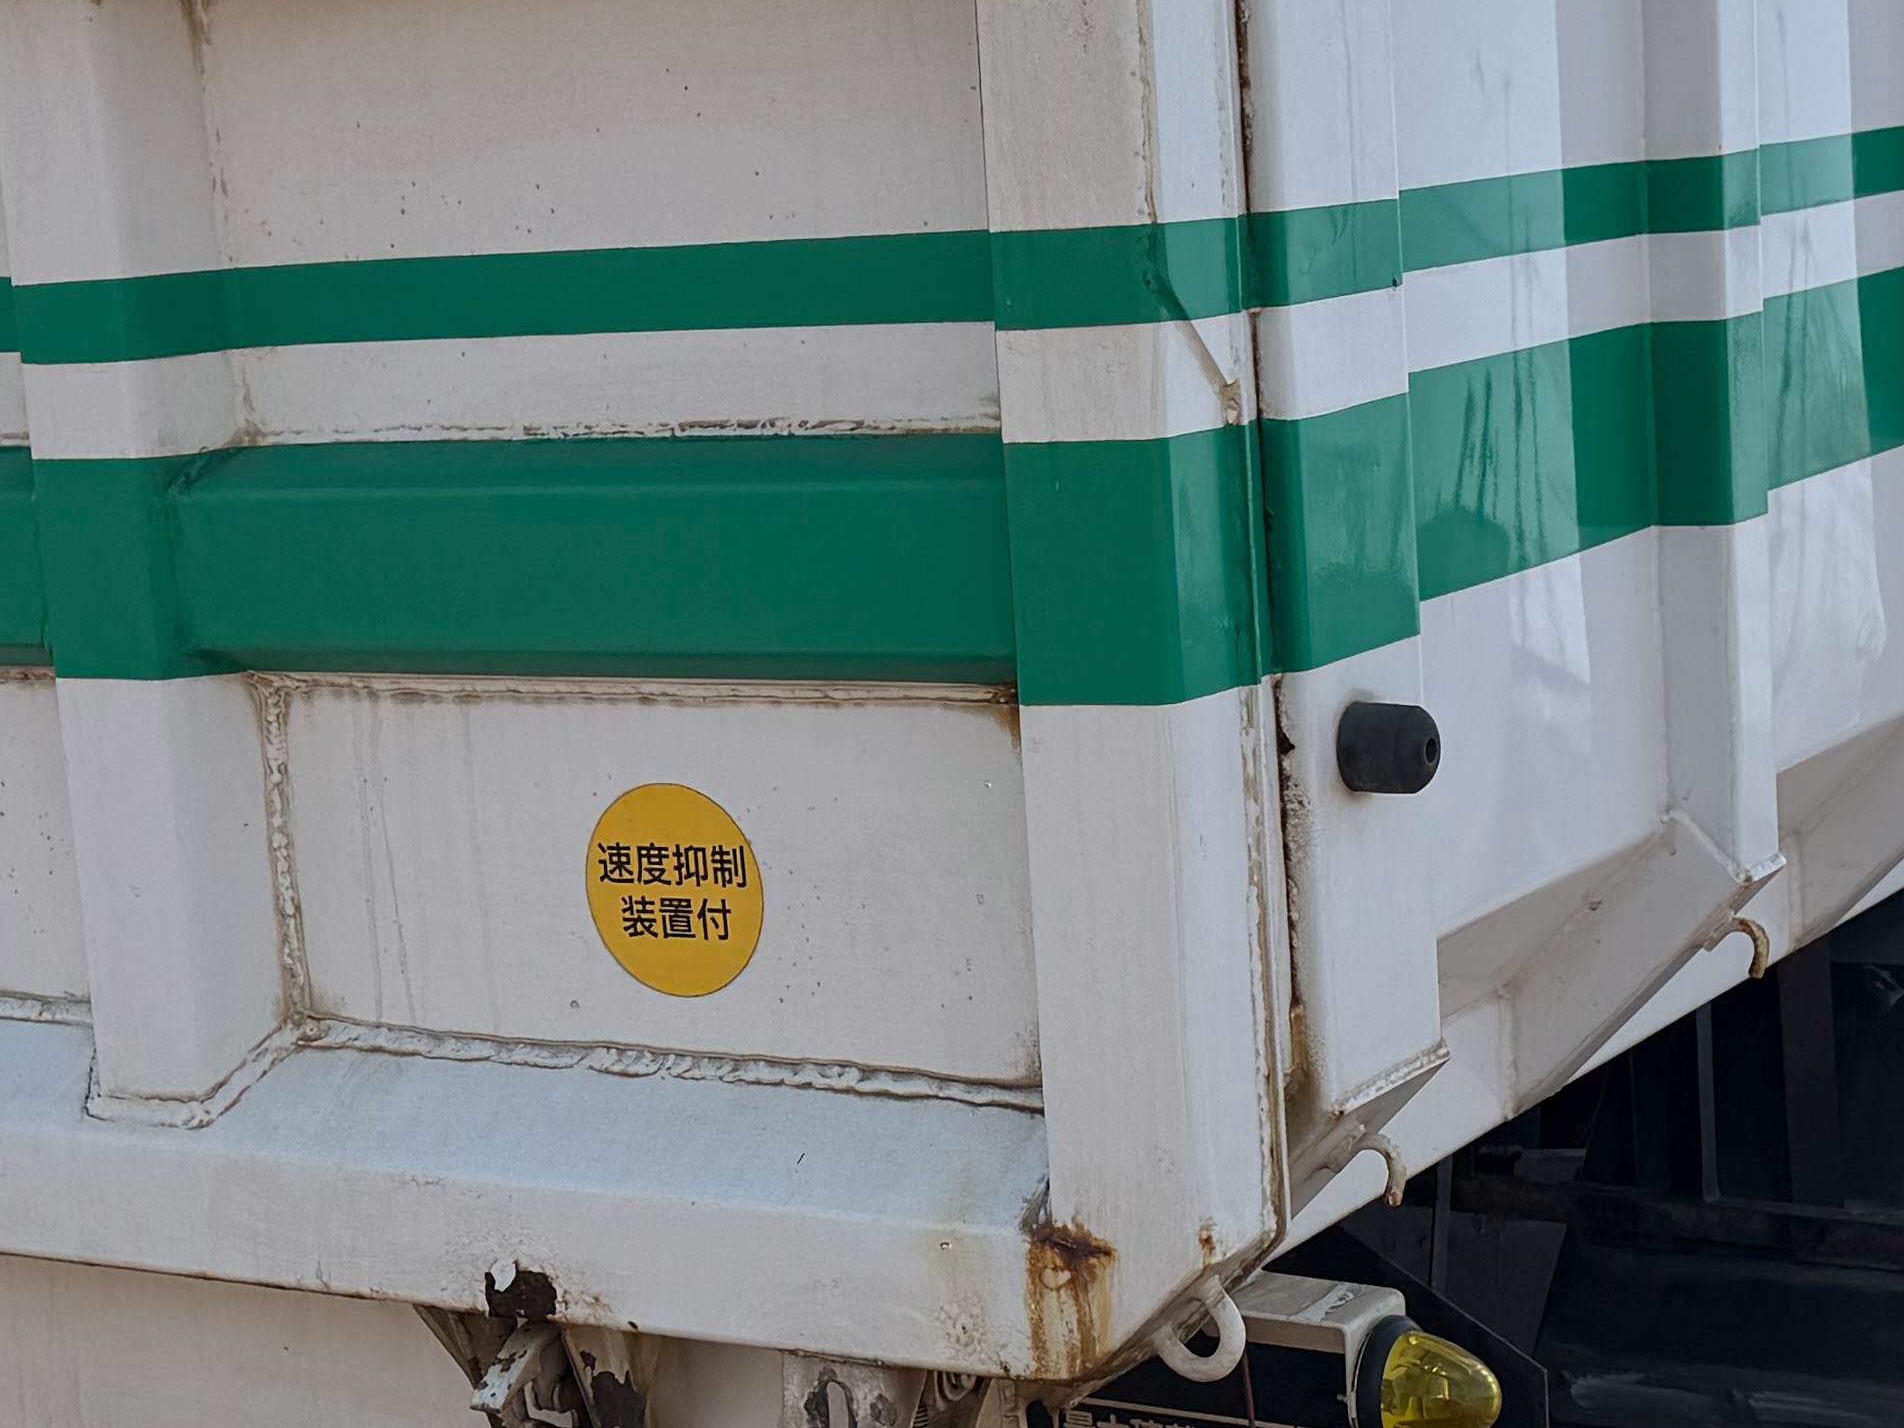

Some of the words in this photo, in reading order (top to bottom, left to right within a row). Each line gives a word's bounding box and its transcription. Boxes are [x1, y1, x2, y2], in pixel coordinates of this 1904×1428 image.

[597, 842, 747, 888] 速度抑制
[621, 895, 731, 941] 装置付
